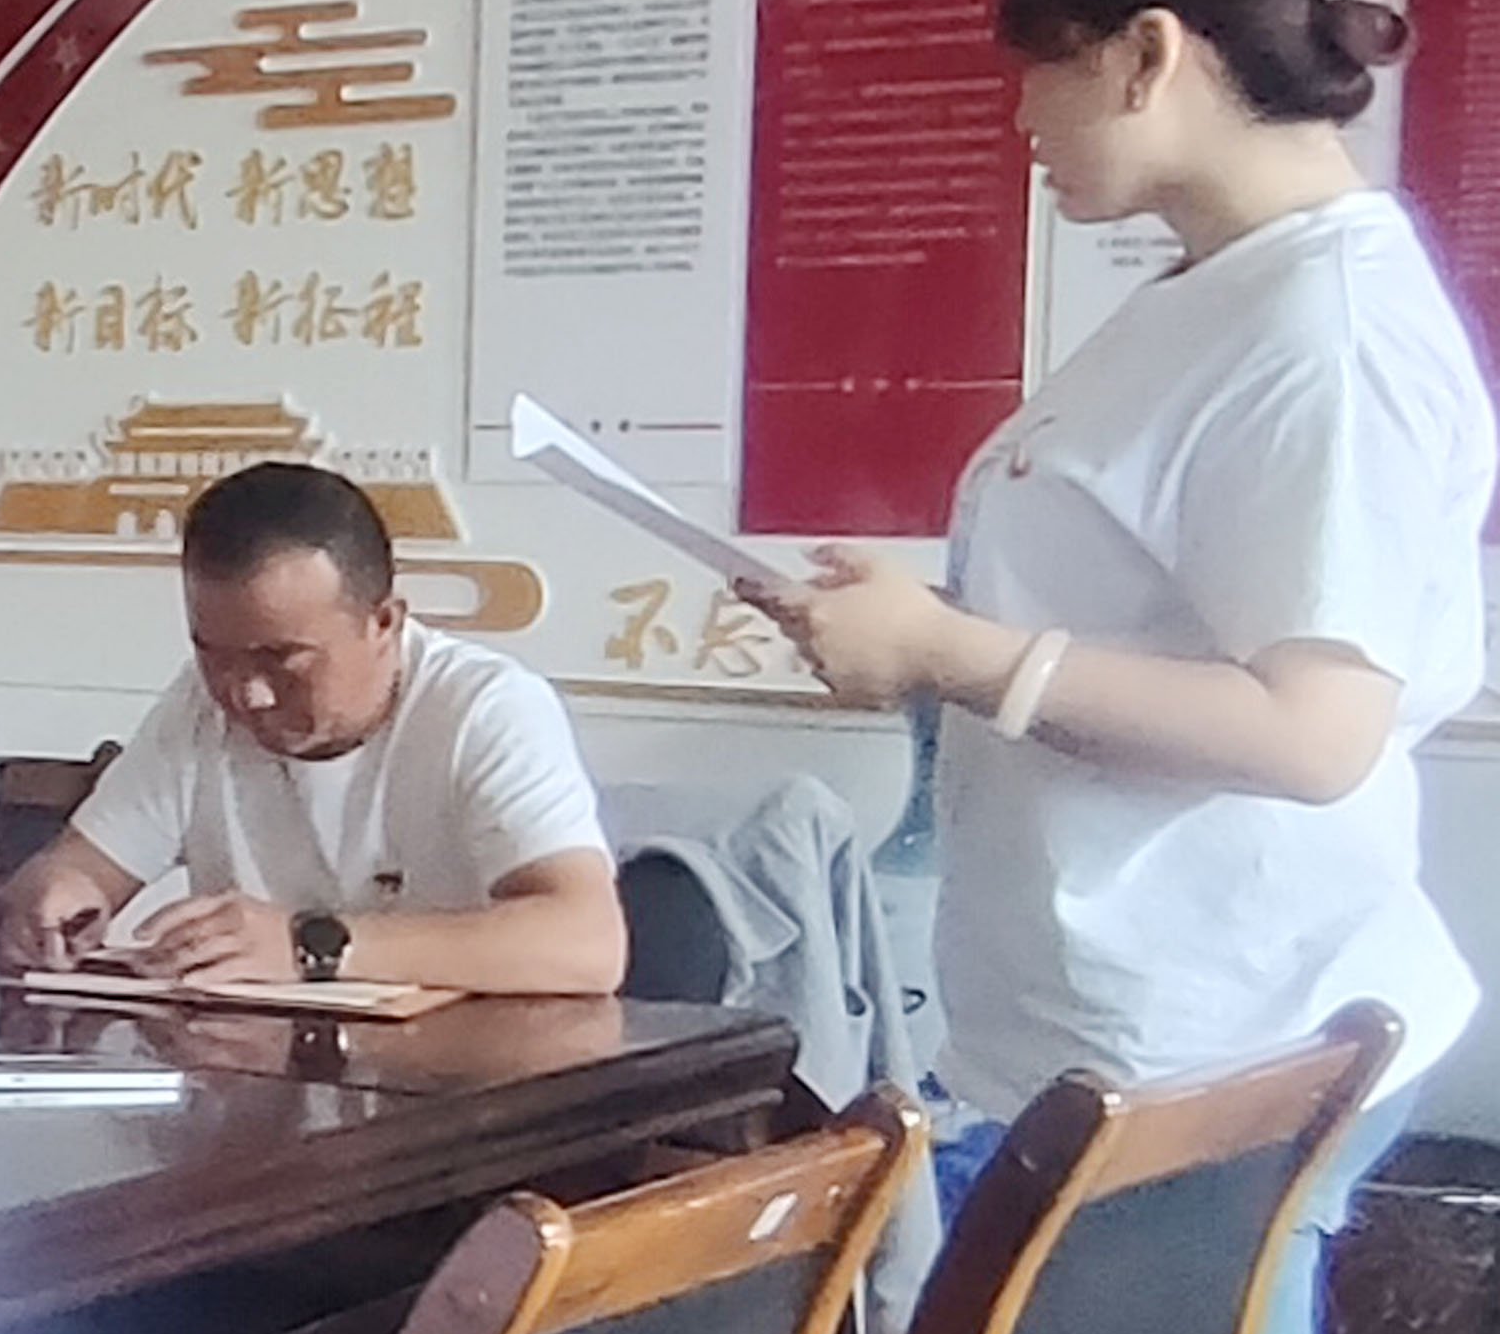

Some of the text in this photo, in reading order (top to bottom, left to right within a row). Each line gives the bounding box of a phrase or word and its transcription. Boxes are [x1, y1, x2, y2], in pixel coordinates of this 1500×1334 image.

[29, 142, 419, 230] 新时代 新思想
[21, 269, 424, 354] 新目标 新征程
